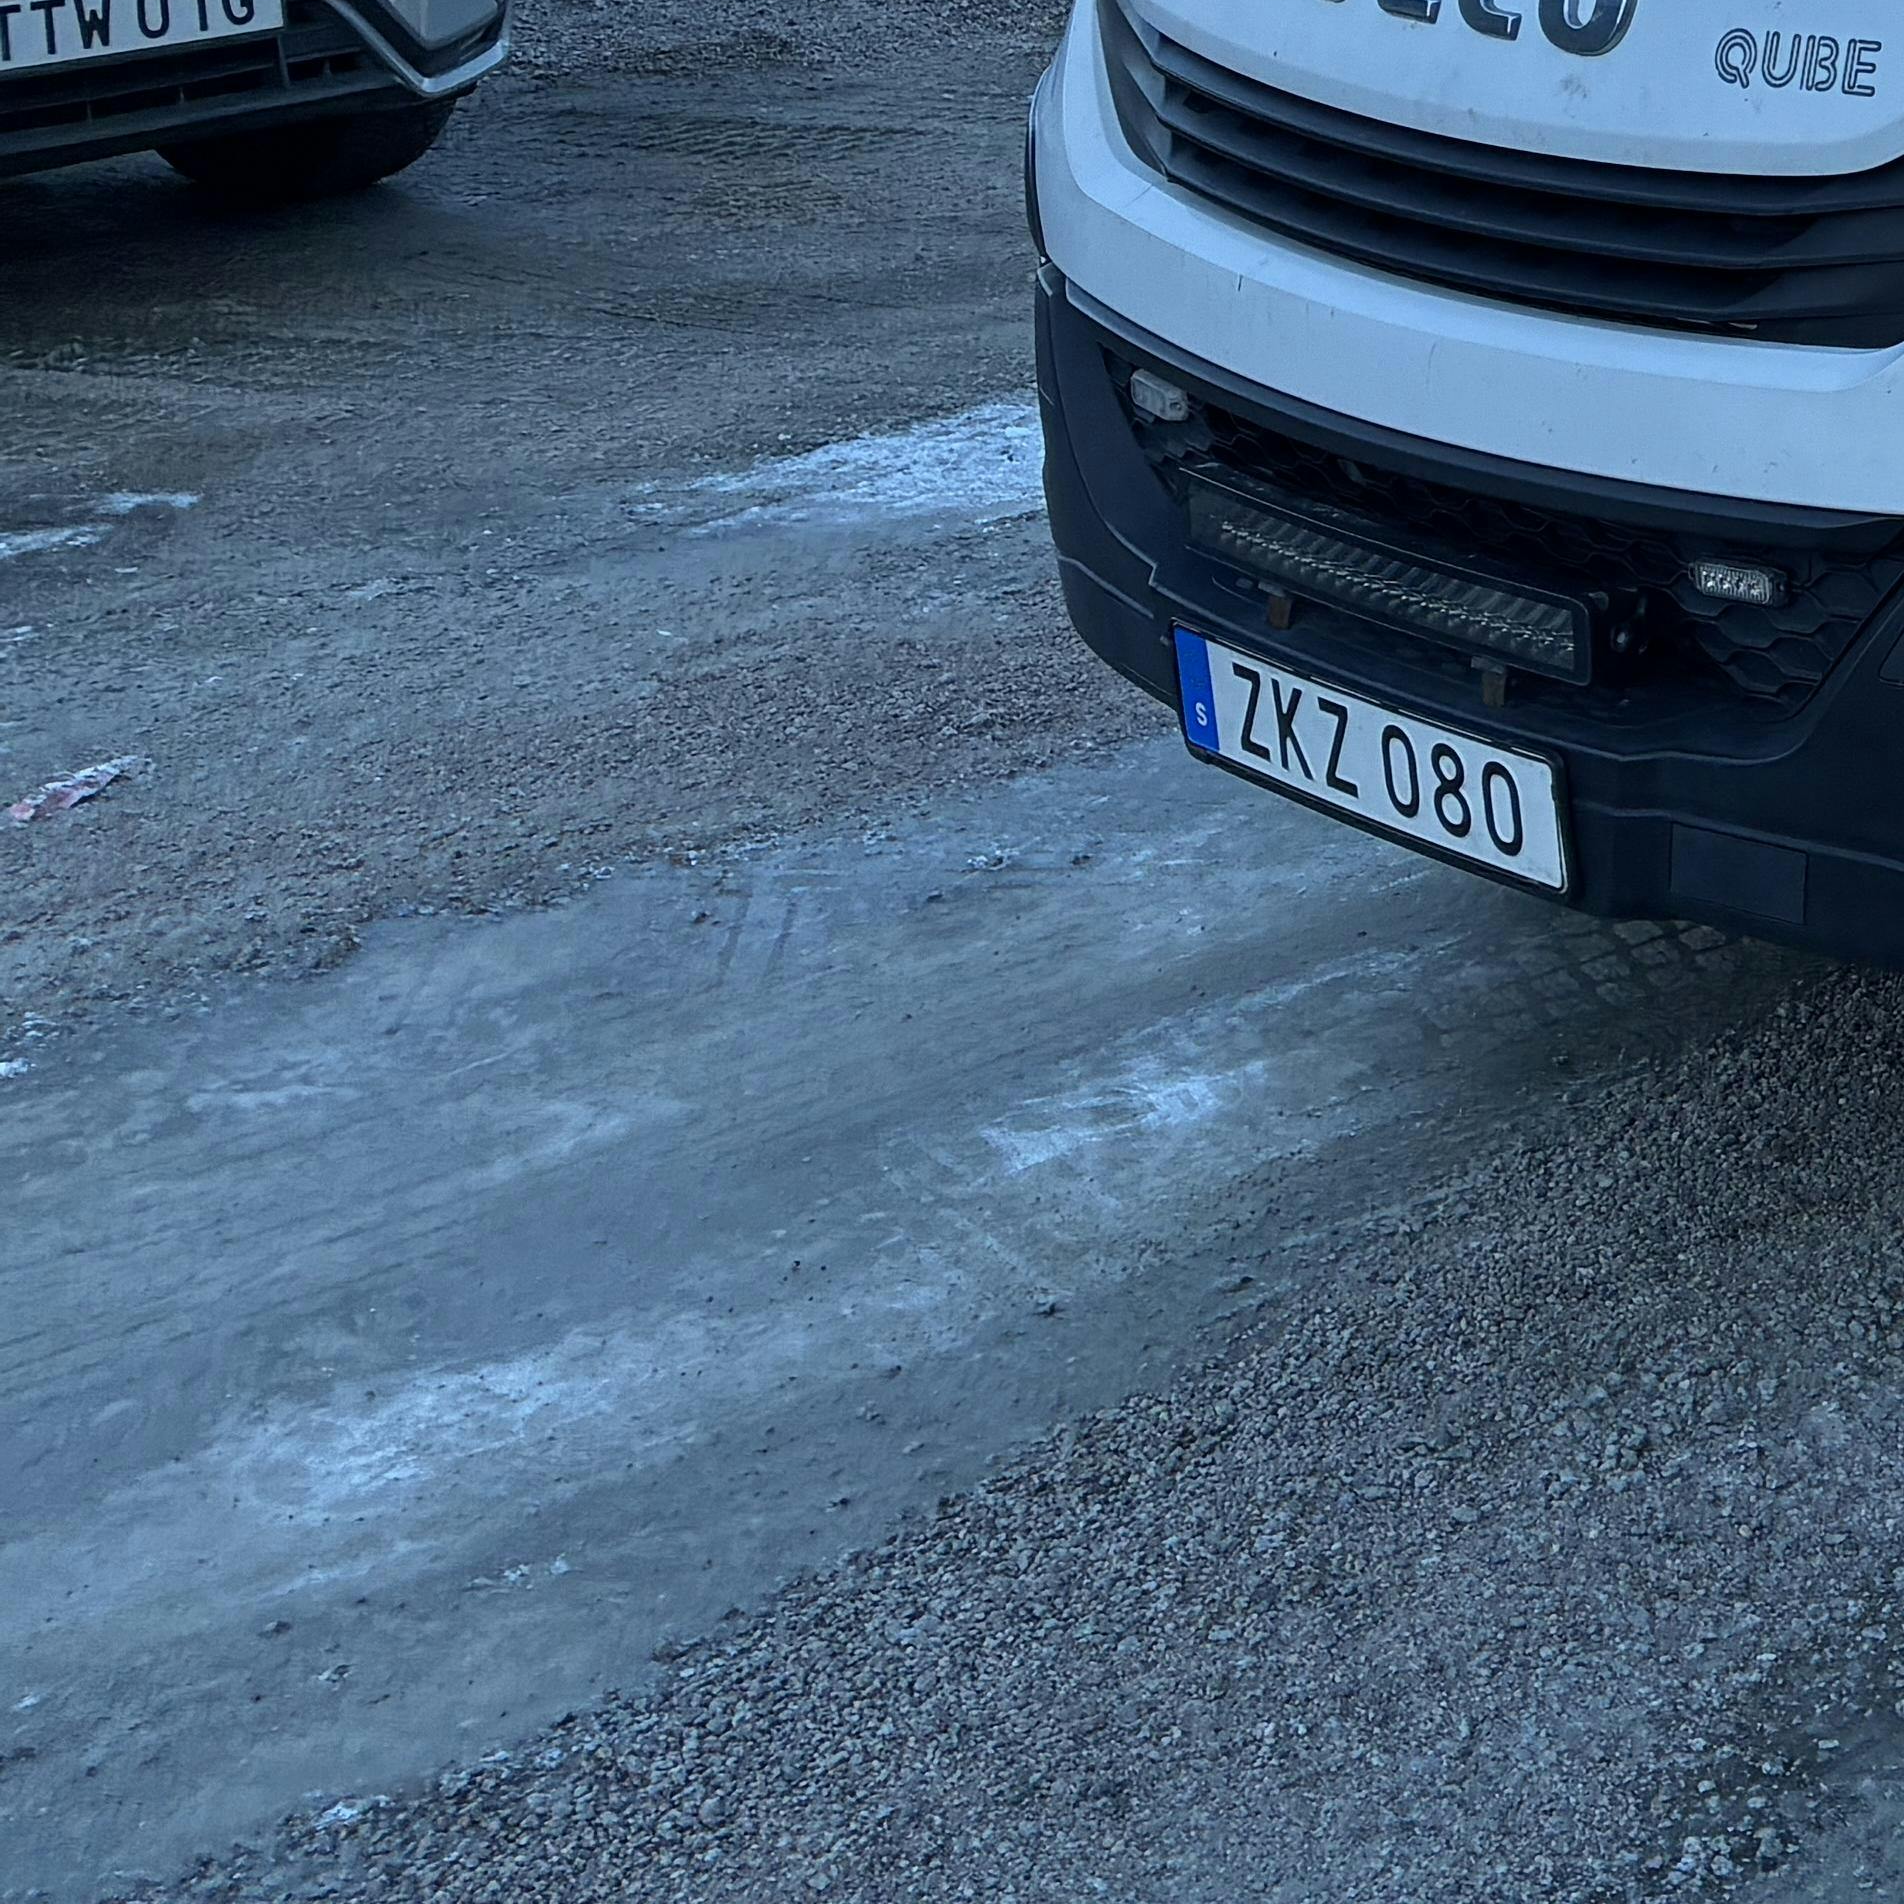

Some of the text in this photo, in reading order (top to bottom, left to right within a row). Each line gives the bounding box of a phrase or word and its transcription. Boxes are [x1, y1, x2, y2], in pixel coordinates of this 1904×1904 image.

[1714, 27, 1883, 97] QUBE
[1195, 702, 1207, 727] S
[1231, 662, 1524, 857] ZKZ 080
